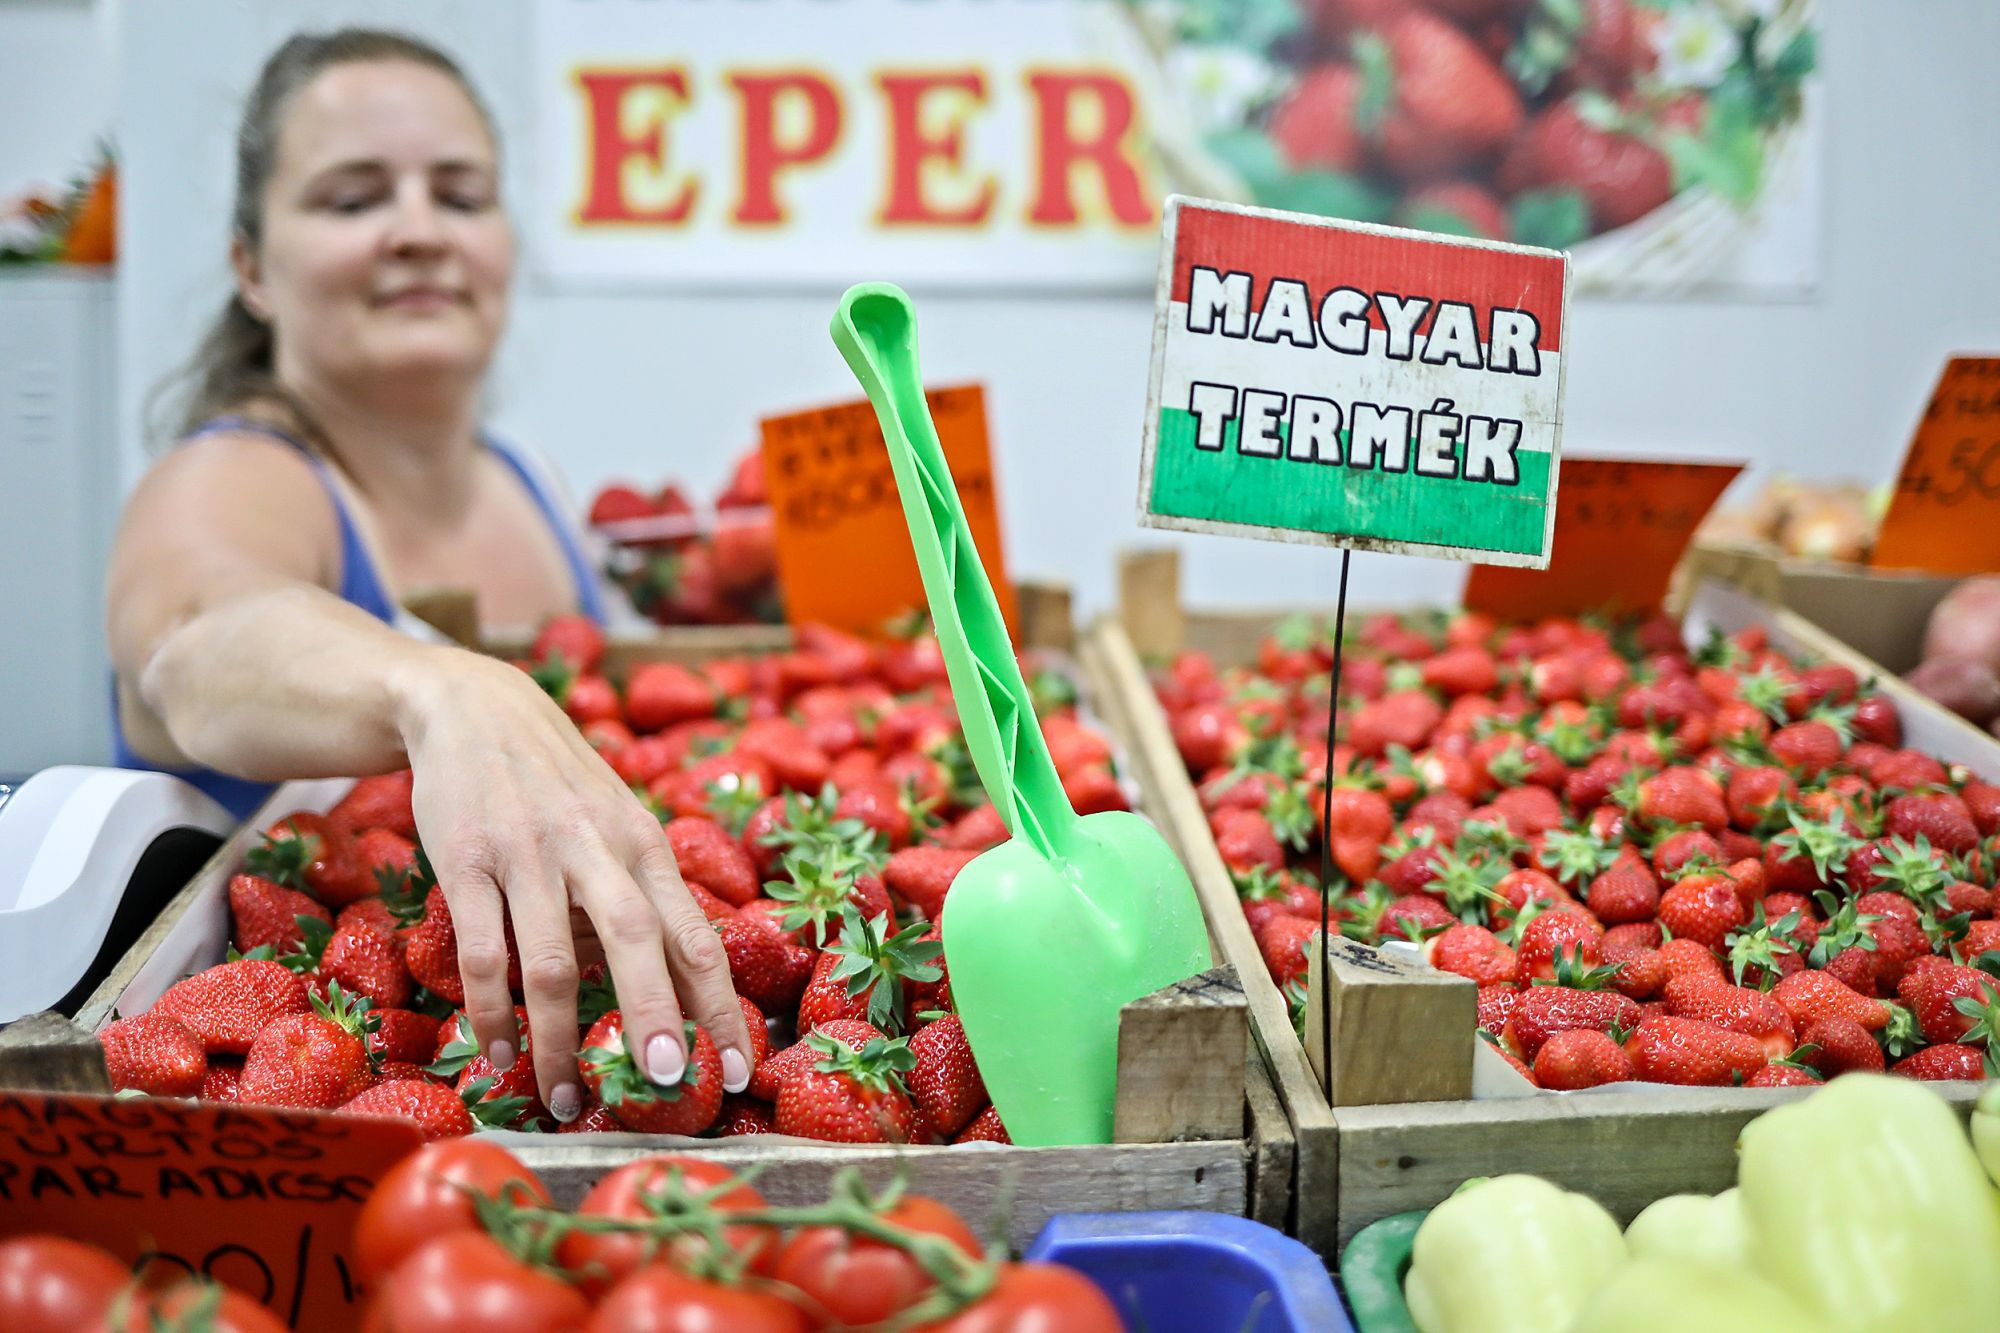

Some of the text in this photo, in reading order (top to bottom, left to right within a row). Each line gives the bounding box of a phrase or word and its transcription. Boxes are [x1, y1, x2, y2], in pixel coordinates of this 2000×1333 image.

[570, 63, 1158, 231] EPER
[1186, 266, 1542, 377] MAGYAR
[1189, 381, 1523, 487] TERMÉK
